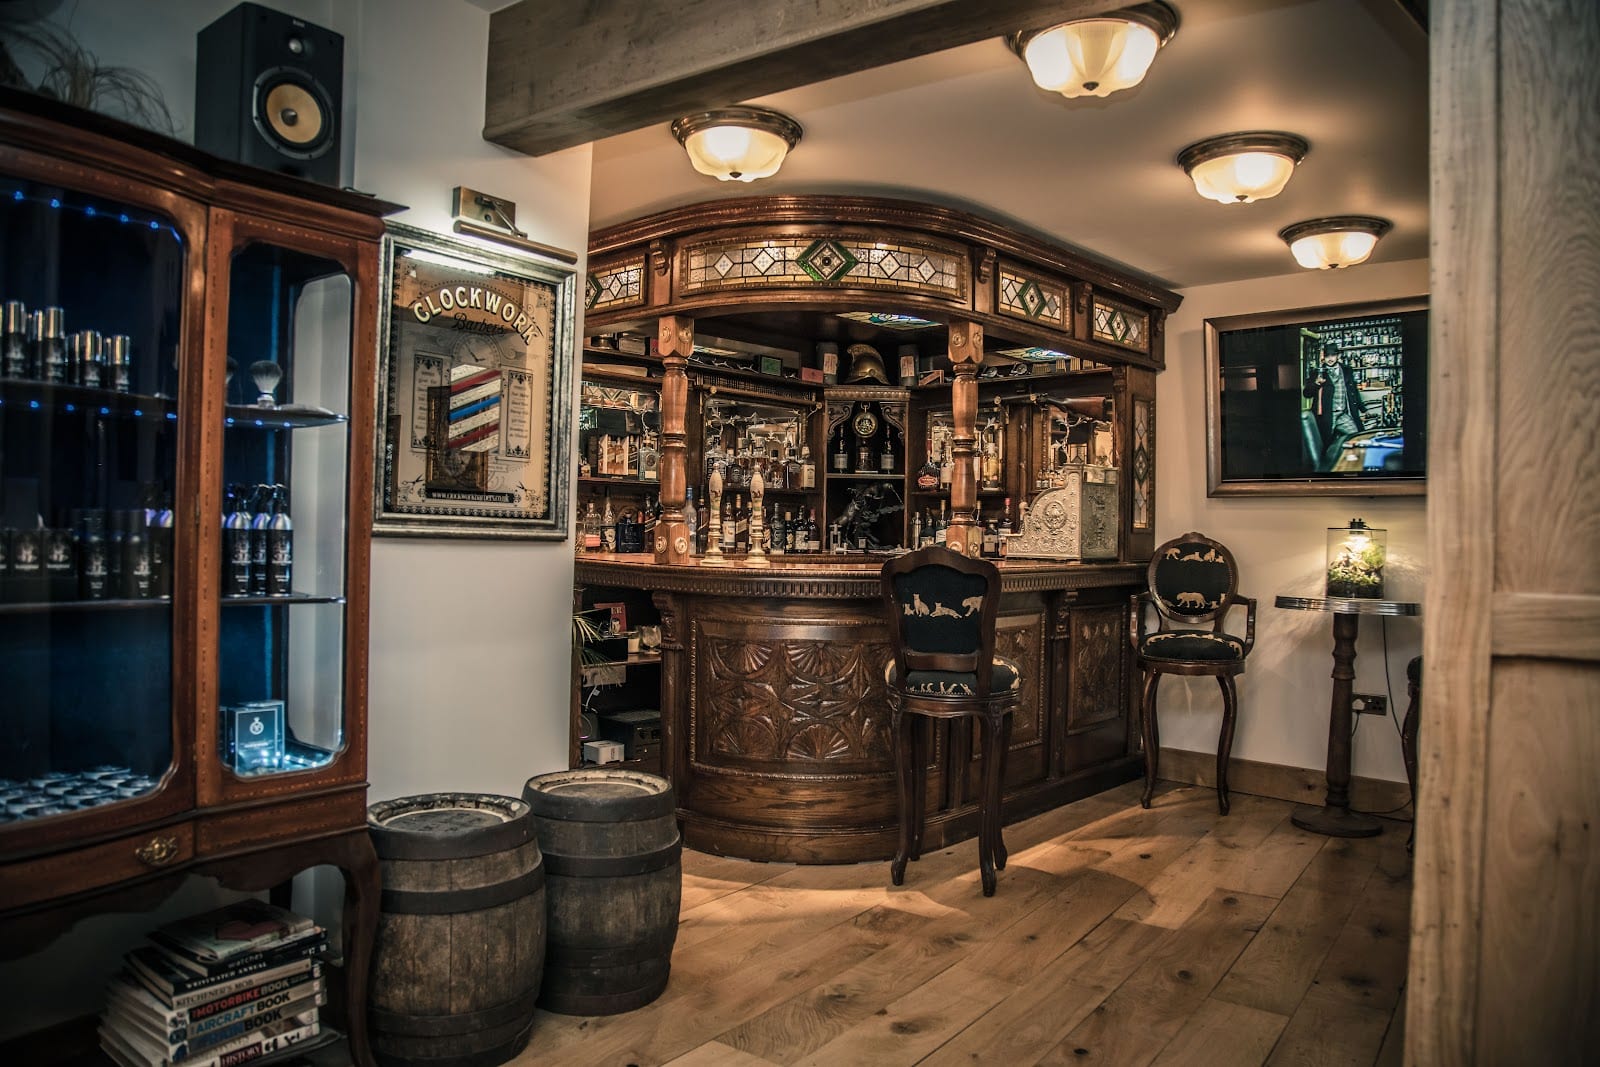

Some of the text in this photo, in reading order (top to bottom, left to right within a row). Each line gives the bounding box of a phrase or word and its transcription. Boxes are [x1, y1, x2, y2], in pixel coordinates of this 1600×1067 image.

[413, 286, 541, 346] CLOCKWORK
[452, 312, 505, 336] Barbers
[196, 987, 261, 1018] MOTORBIKE
[260, 979, 290, 996] BOOK
[197, 991, 290, 1034] AIRCRAFT BOOK
[244, 1007, 283, 1031] BOOK
